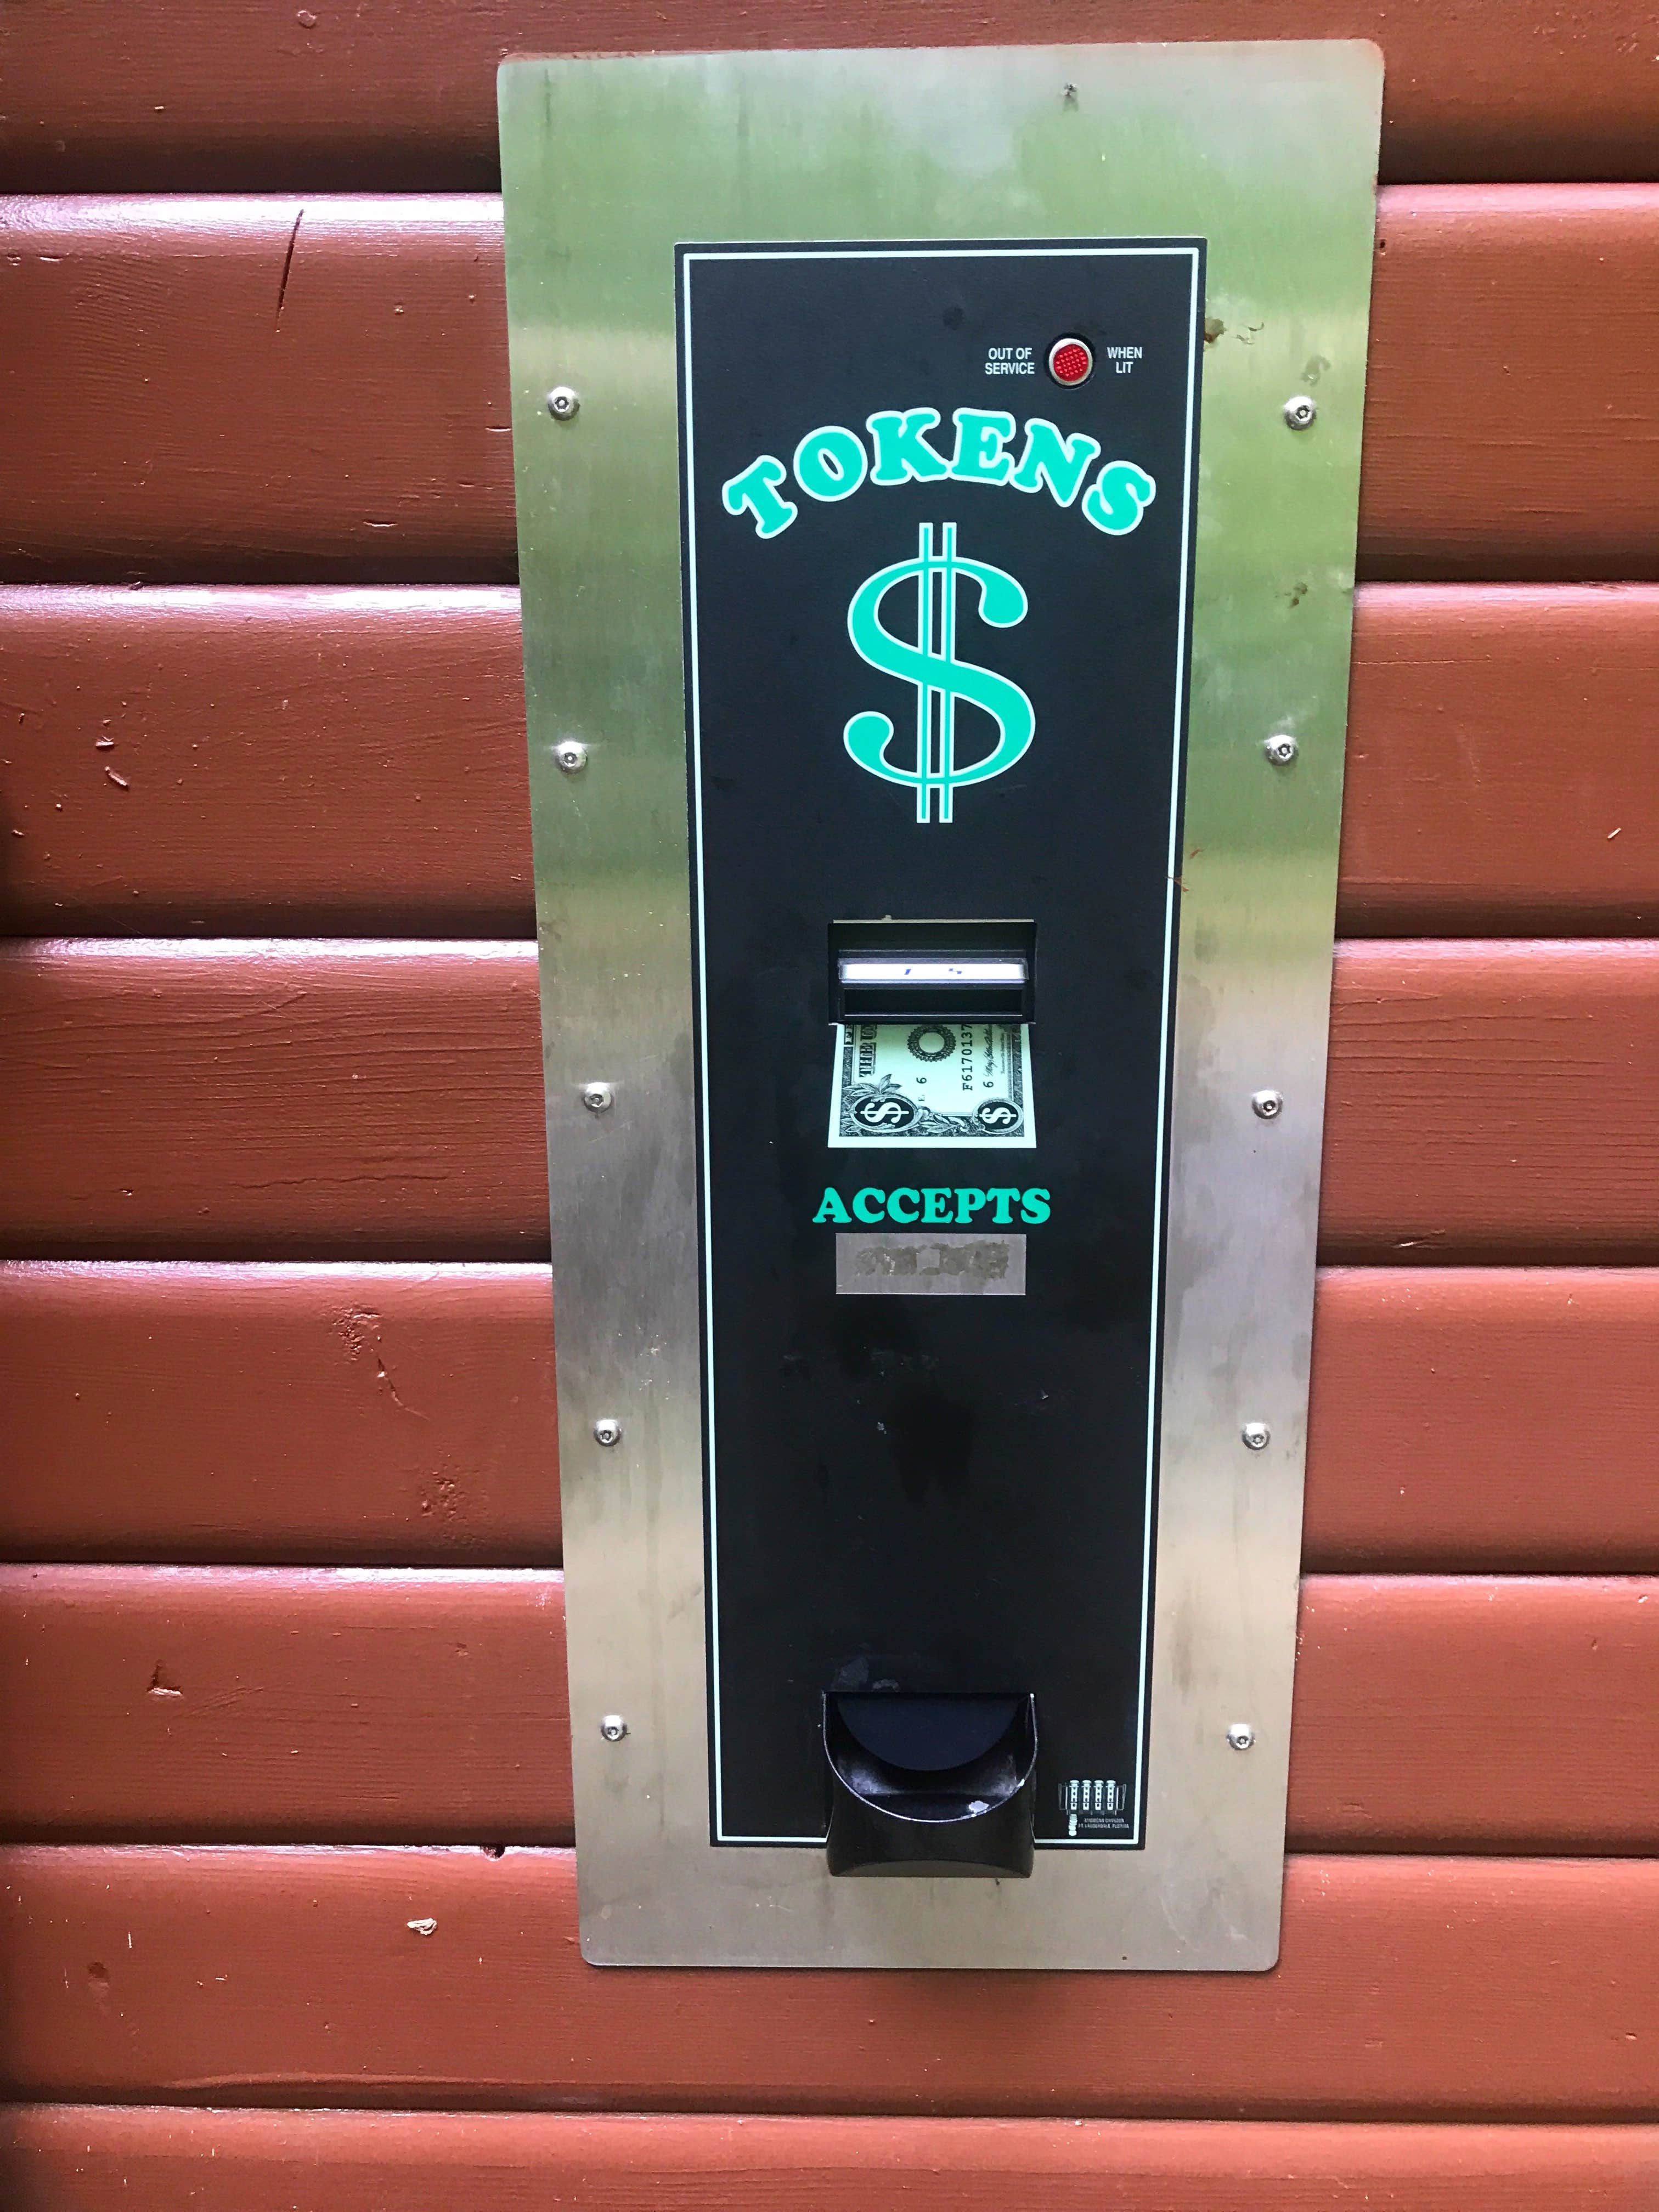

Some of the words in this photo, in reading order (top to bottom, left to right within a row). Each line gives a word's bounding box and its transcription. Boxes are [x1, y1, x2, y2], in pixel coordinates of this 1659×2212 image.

[988, 348, 1013, 360] OUT
[1015, 347, 1032, 359] OF
[1107, 347, 1142, 359] WHEN
[985, 362, 1035, 375] SERVICE
[1115, 362, 1134, 374] LIT
[722, 407, 1156, 539] TOKENS
[843, 522, 1036, 823] $
[859, 1042, 876, 1077] THE
[812, 1187, 1051, 1224] ACCEPTS
